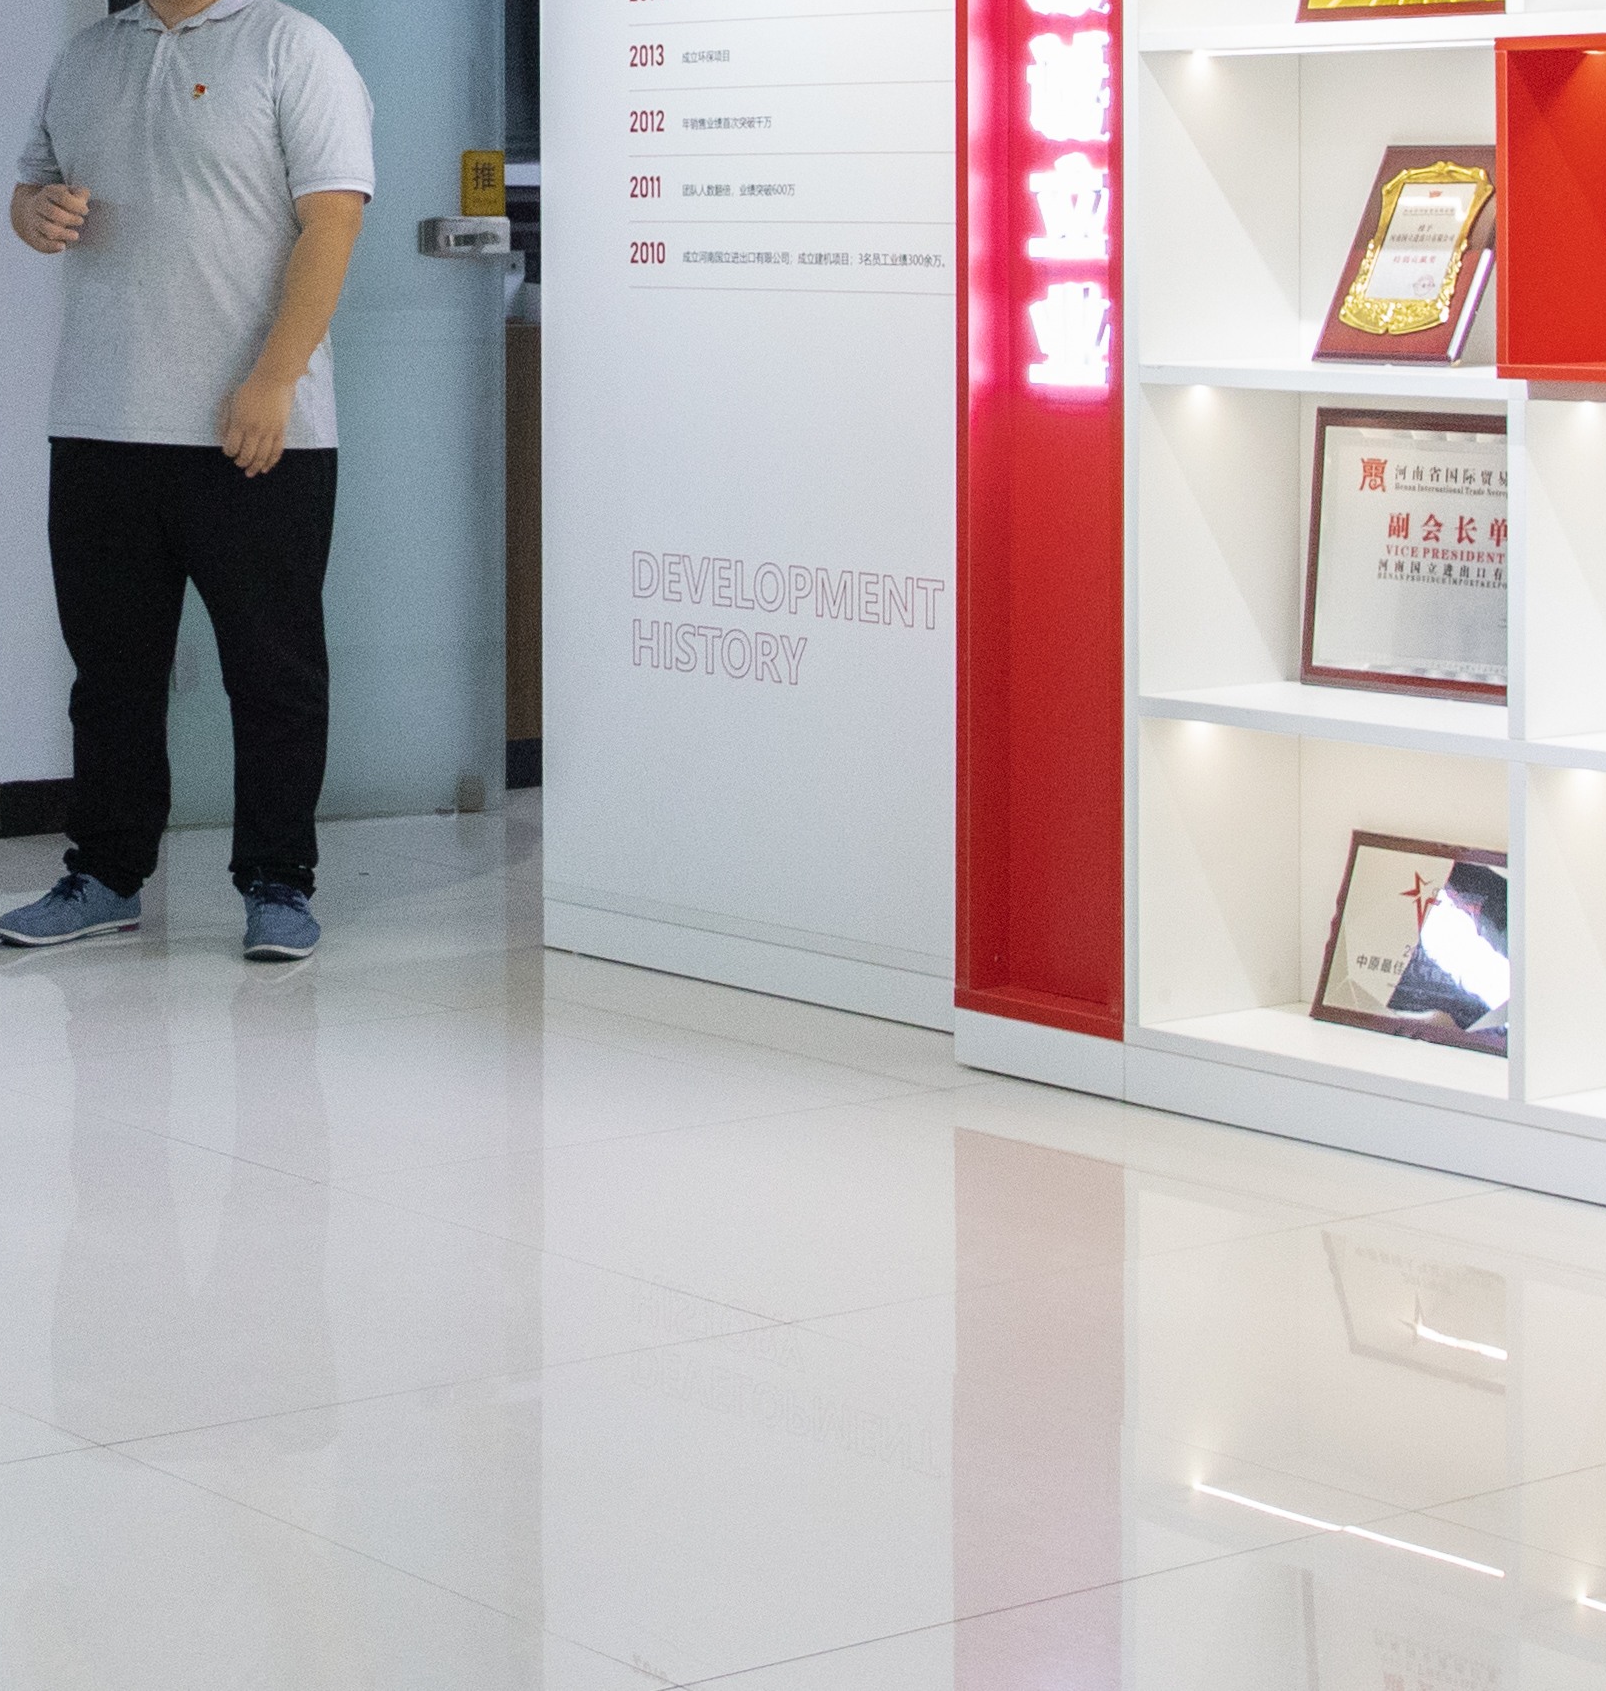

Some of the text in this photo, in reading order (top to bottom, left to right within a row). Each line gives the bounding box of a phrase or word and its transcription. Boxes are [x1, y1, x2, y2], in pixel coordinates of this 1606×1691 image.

[629, 44, 665, 68] 2013
[629, 110, 666, 133] 2012
[472, 161, 497, 192] 推
[629, 176, 662, 199] 2011
[630, 241, 666, 265] 2010
[1386, 544, 1506, 565] VICE PRESIDENT
[632, 550, 945, 630] DEVELOPMENT
[632, 618, 808, 686] HISTORY
